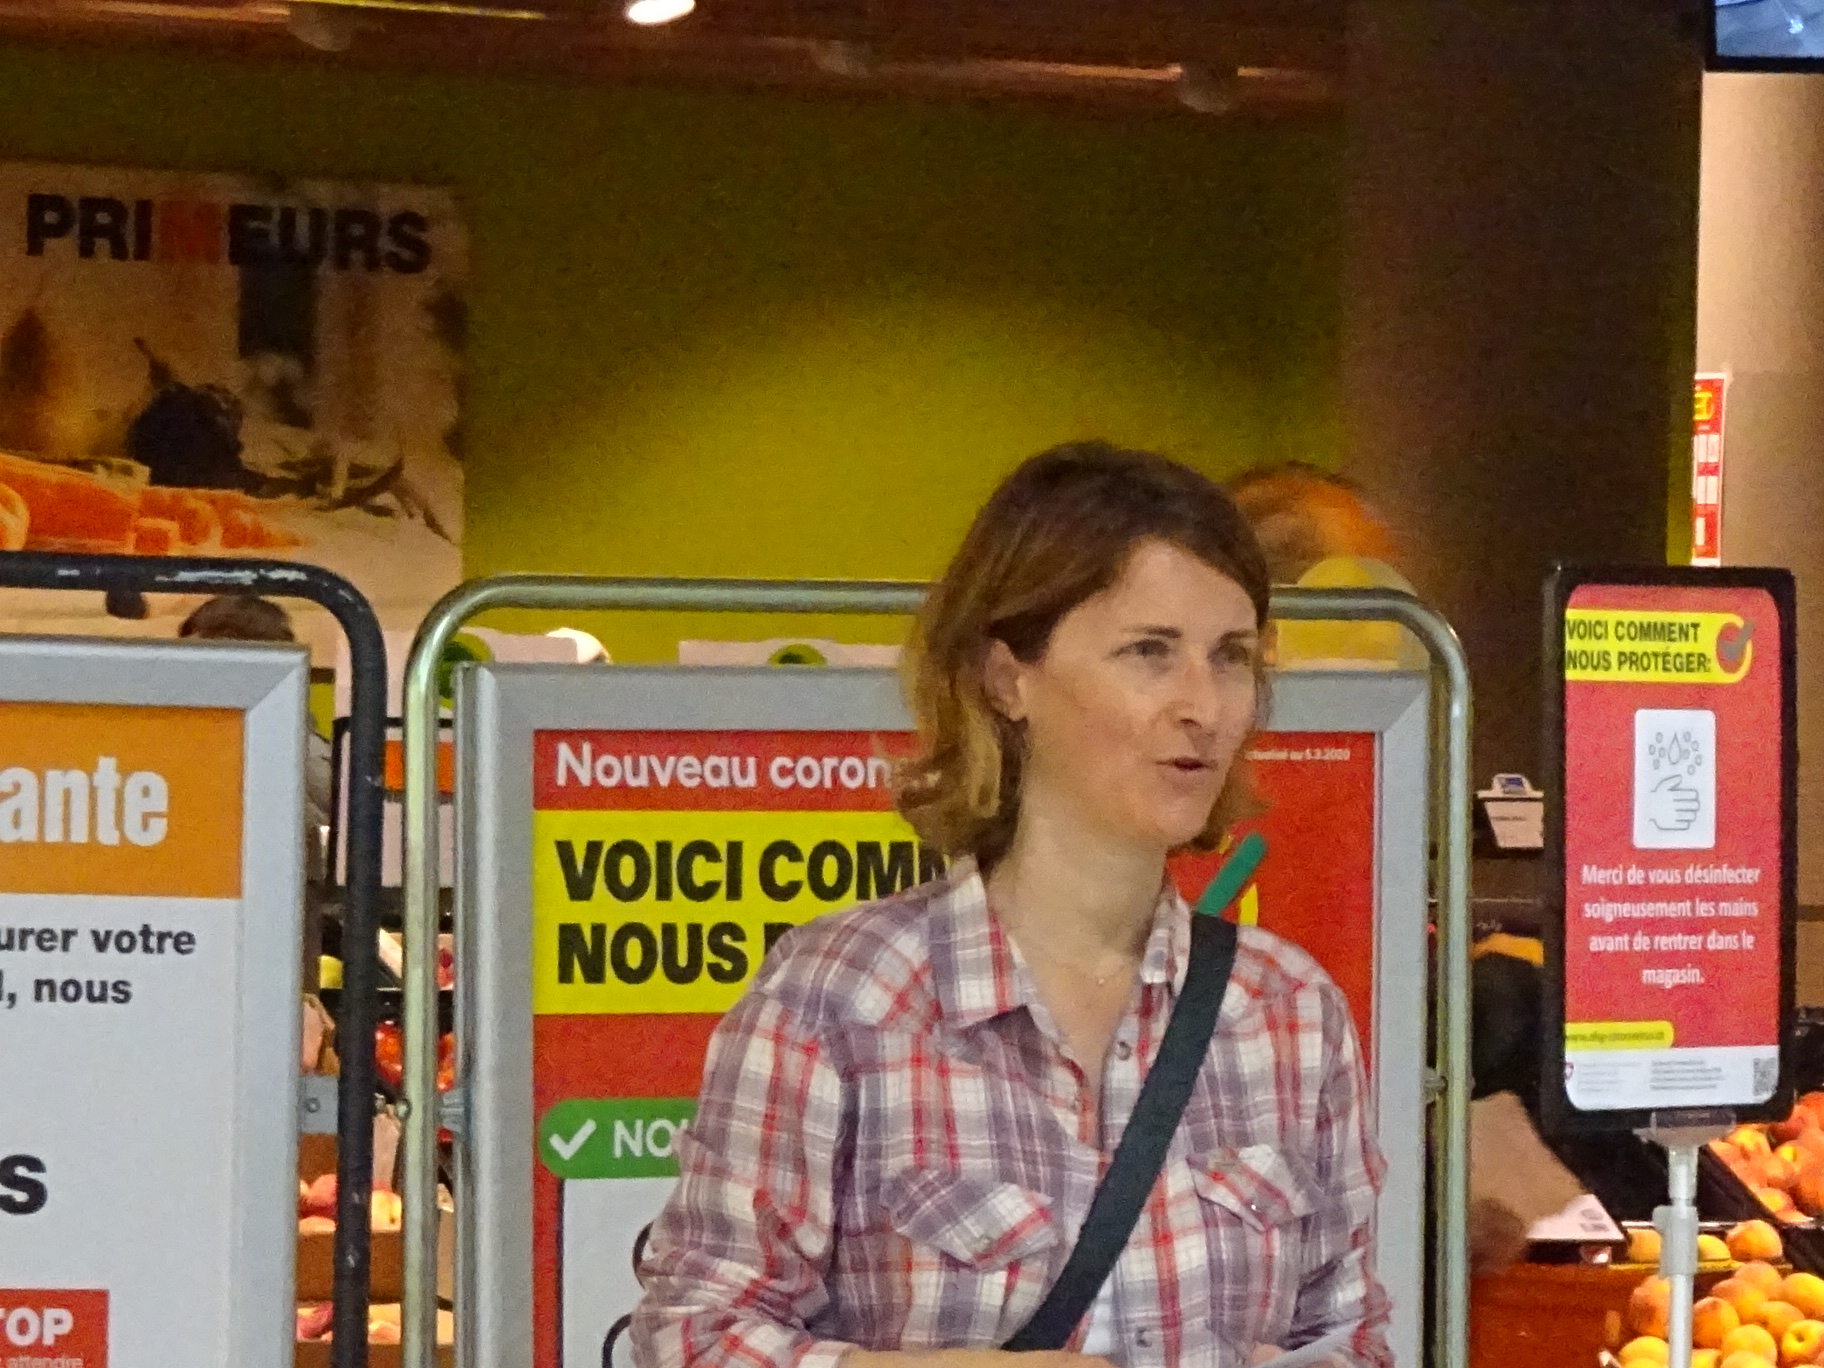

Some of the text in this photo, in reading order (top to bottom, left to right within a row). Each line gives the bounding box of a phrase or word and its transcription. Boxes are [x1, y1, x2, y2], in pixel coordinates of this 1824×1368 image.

[27, 194, 432, 274] PRIMEURS
[1566, 619, 1700, 643] VOICI COMMENT
[1566, 650, 1611, 672] NOUS
[555, 741, 757, 788] Nouveau
[0, 757, 169, 847] ante
[554, 838, 743, 903] VOICI
[1581, 864, 1761, 884] Merci de vous désinfecter
[1584, 898, 1758, 922] soigneusement les mains
[90, 924, 196, 955] votre
[557, 921, 749, 985] NOUS
[1589, 930, 1755, 951] avant de rentrer dans le
[33, 977, 132, 1004] nous
[1642, 964, 1705, 989] magasin.
[0, 1307, 74, 1346] OP
